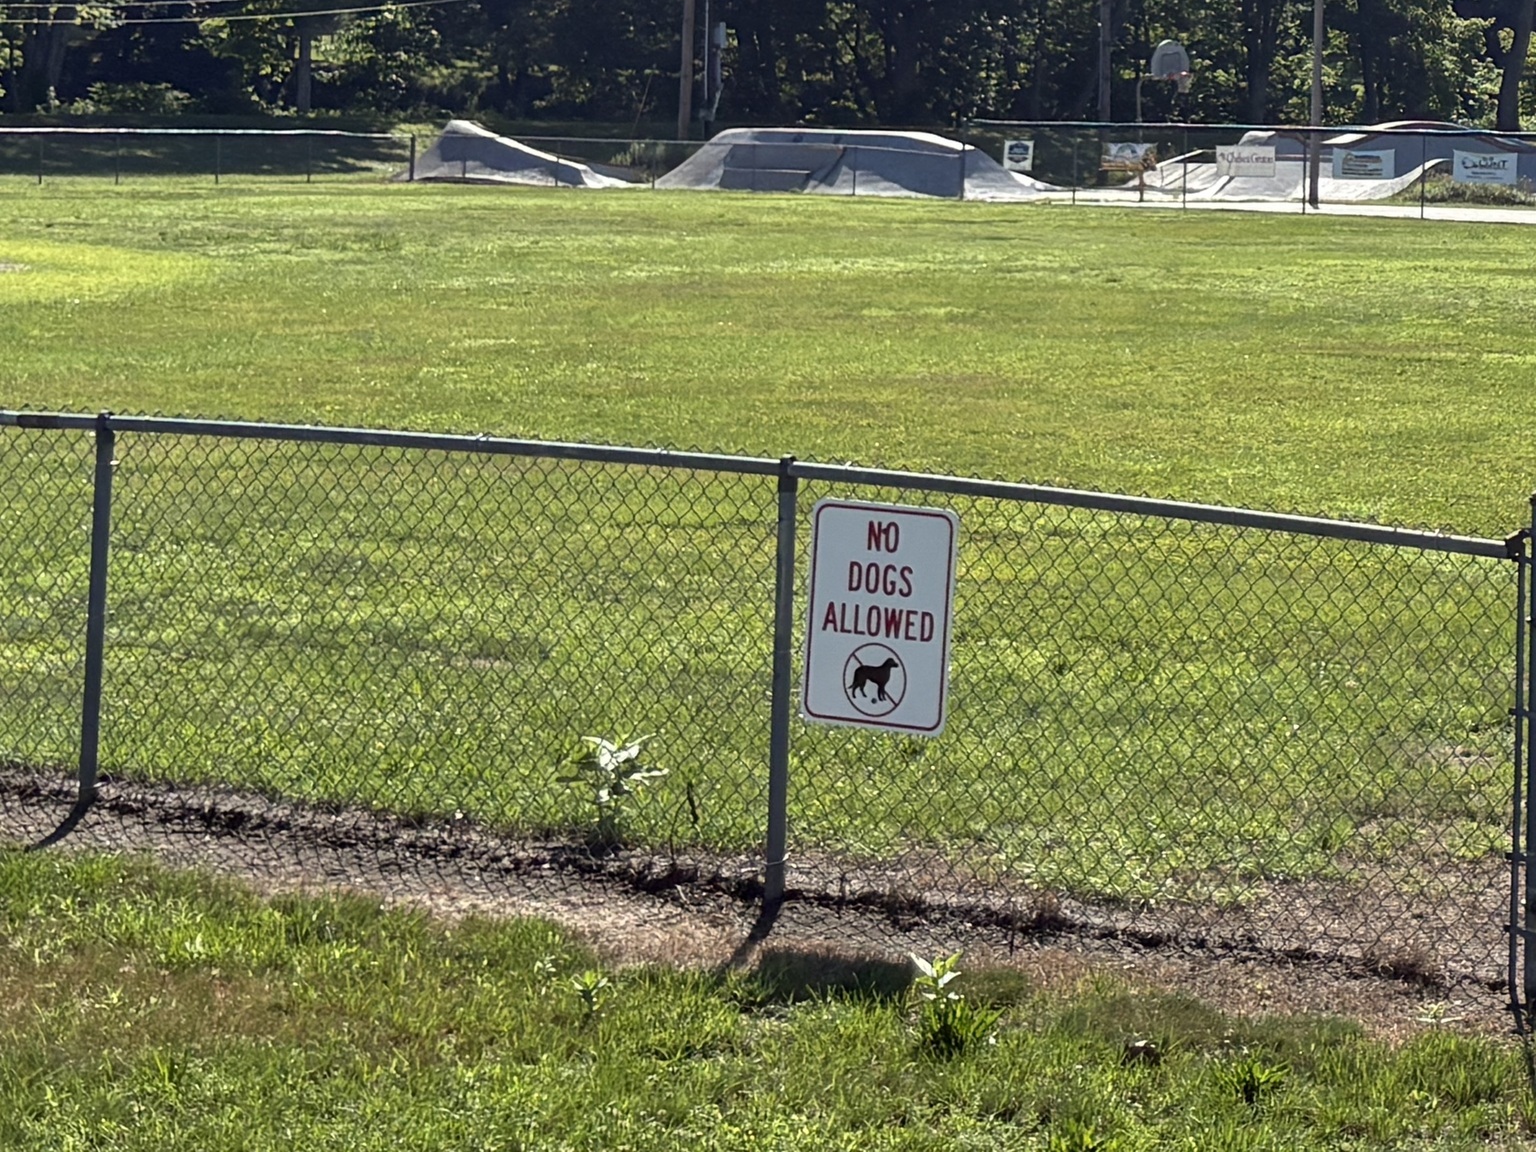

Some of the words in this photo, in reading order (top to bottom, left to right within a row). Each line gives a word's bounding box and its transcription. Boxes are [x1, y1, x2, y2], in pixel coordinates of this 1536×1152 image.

[867, 520, 900, 553] NO
[848, 561, 914, 598] DOGS
[822, 601, 935, 643] ALLOWED
